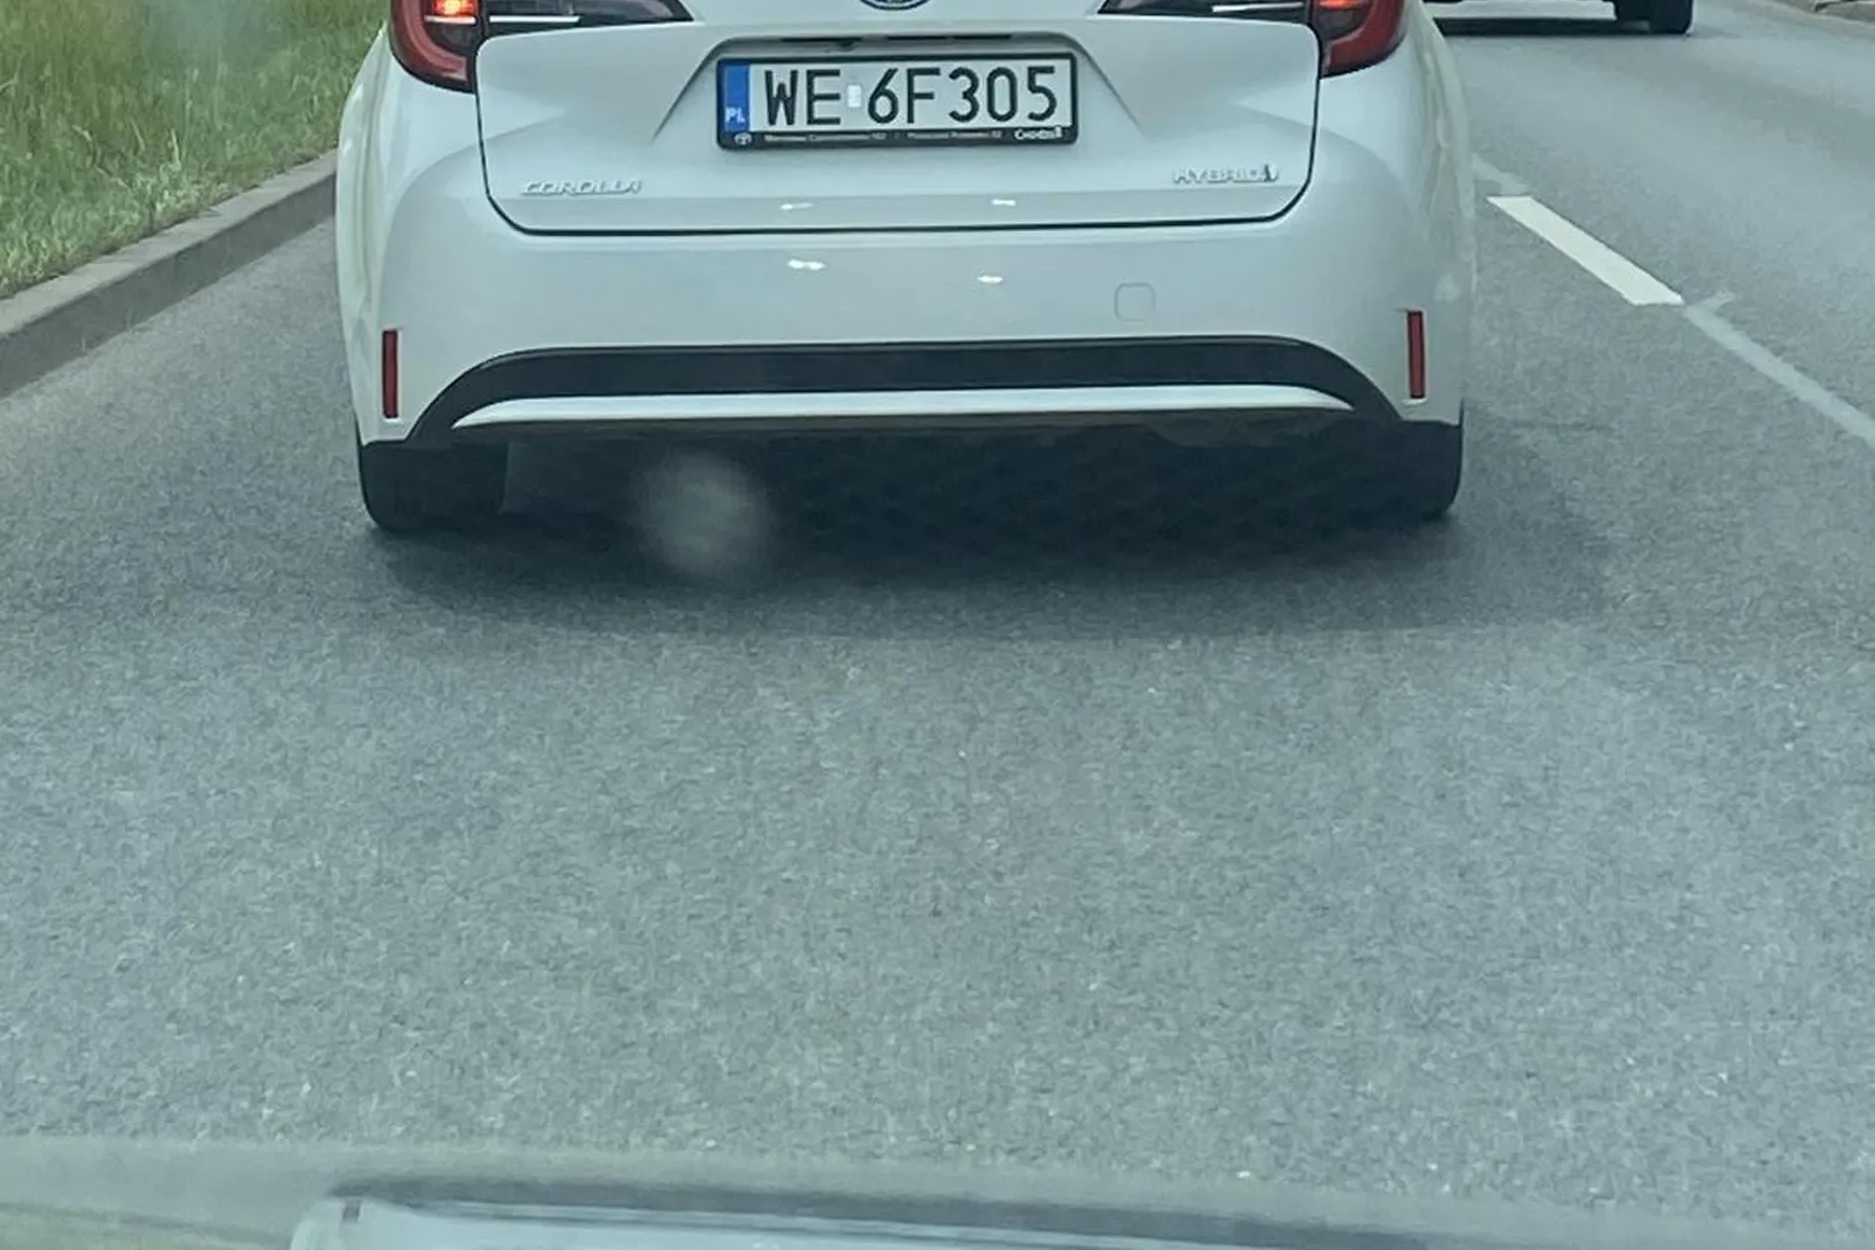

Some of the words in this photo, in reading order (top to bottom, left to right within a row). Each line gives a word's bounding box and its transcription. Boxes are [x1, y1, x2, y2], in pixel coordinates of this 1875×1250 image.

[764, 69, 841, 126] WE
[868, 65, 1057, 125] 6F305
[725, 107, 746, 124] PL
[522, 180, 643, 197] COROLLA
